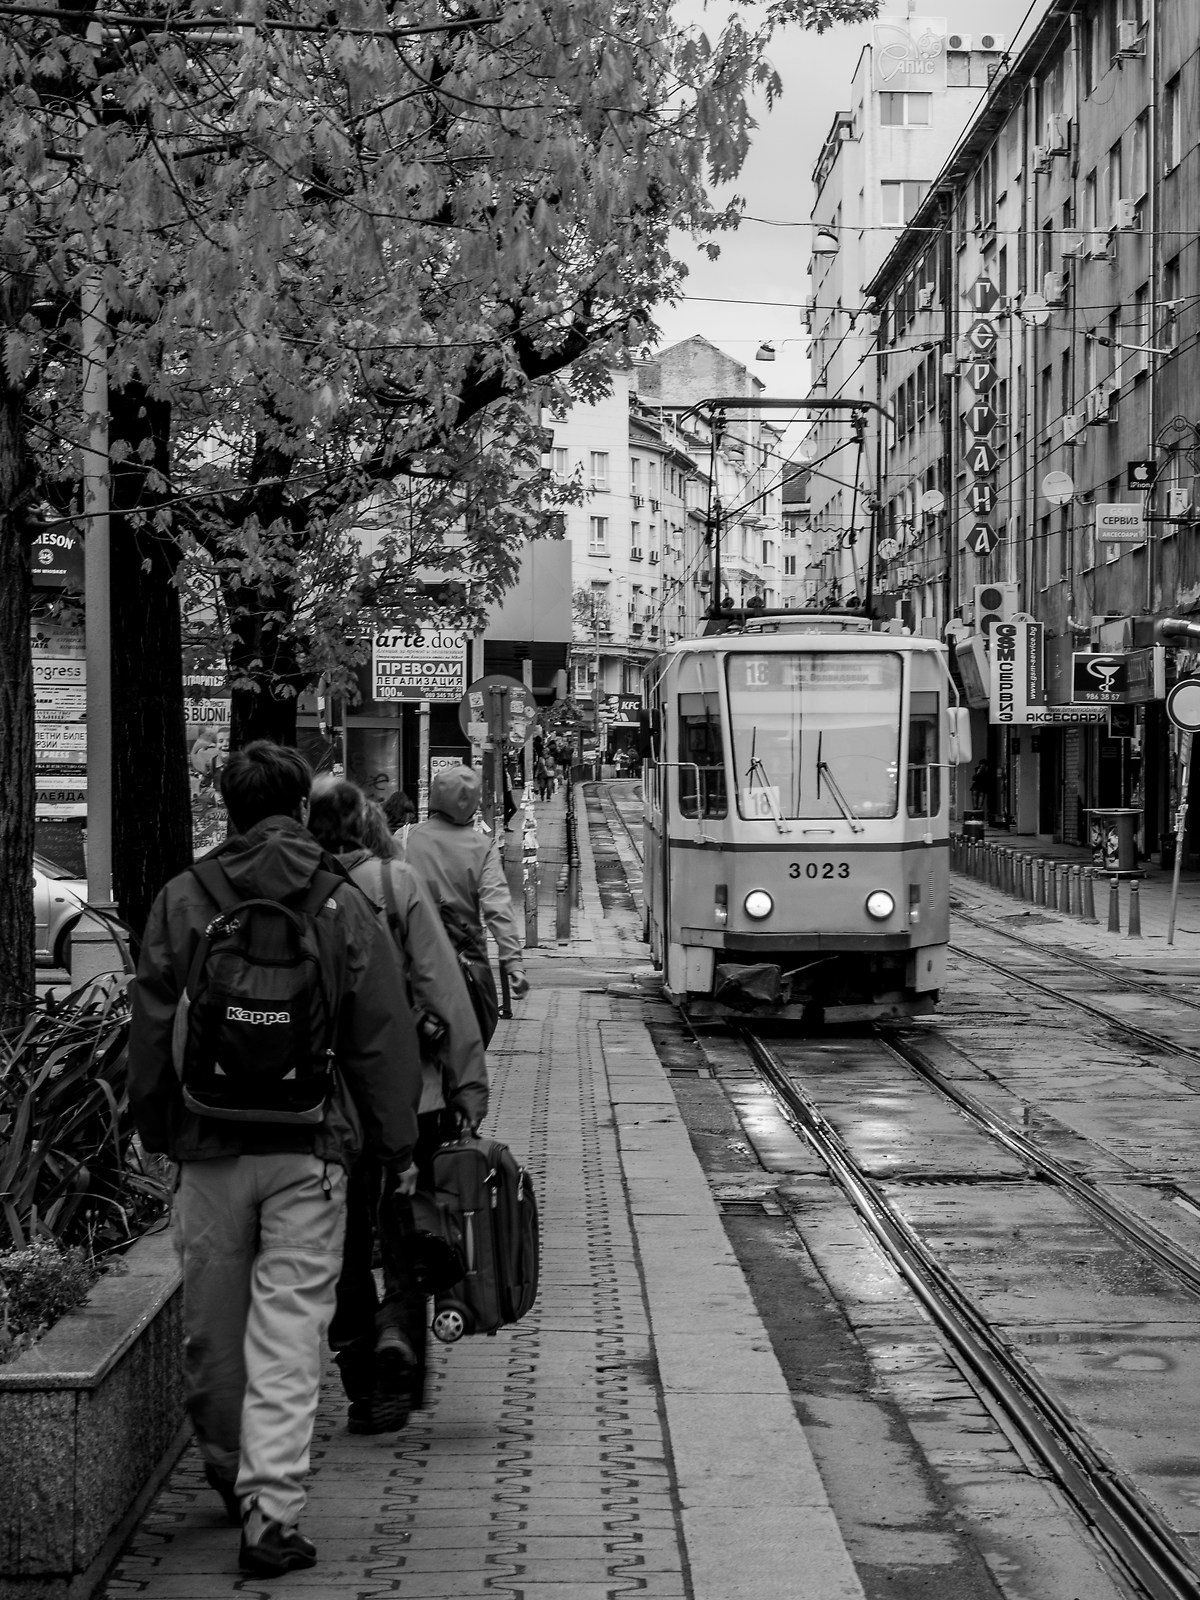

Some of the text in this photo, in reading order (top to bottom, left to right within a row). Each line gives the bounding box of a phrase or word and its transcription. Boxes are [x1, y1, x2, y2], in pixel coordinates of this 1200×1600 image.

[897, 60, 935, 74] АПИС
[1102, 516, 1139, 525] СЕРВИЗ
[375, 631, 465, 649] arte.doc
[996, 624, 1017, 662] GSM
[377, 662, 462, 676] ПРЕВОДИ
[746, 662, 769, 685] 18
[376, 677, 463, 686] ЛЕГАЛИЗАЦИЯ
[379, 686, 397, 697] 100
[999, 662, 1014, 722] СЕРВИЗ
[621, 701, 640, 710] KFC
[191, 707, 226, 721] BUDNI
[1026, 712, 1107, 723] АКСЕСОАРИ
[788, 862, 851, 879] 3023
[226, 1006, 291, 1025] Kappa
